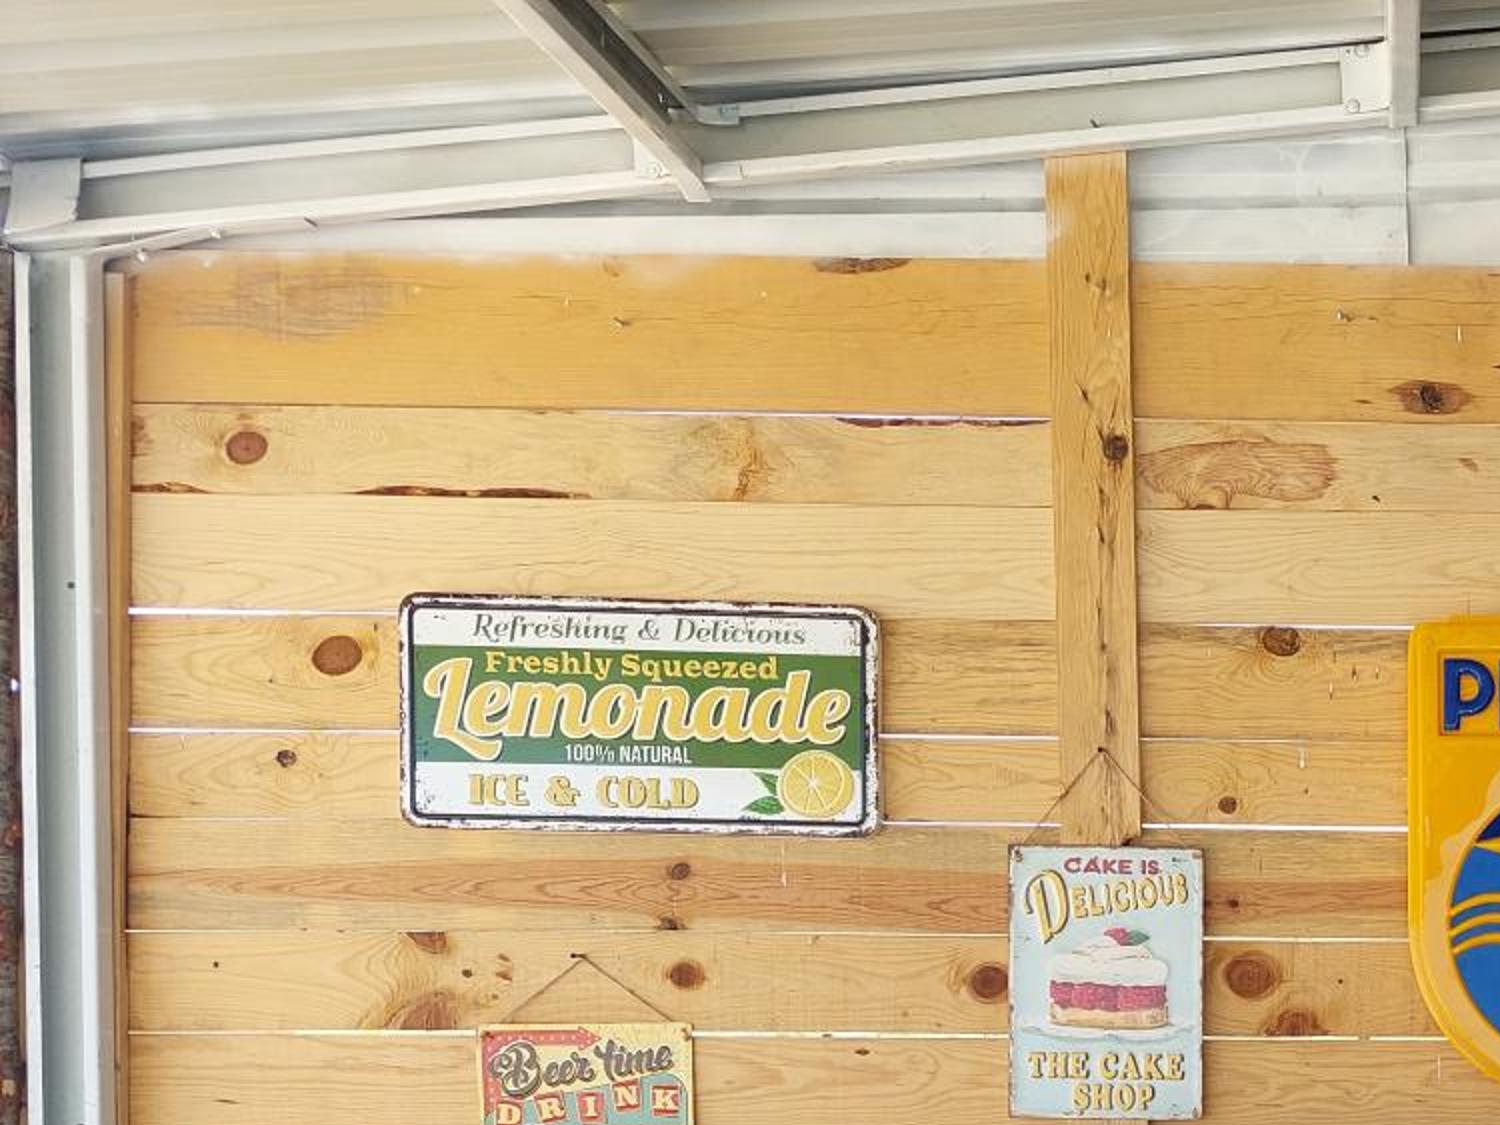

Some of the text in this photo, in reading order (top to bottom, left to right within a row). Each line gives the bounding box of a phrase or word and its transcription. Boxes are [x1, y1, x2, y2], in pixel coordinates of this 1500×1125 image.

[473, 613, 807, 645] Refreshing & Delicious
[485, 651, 779, 682] Freshly Squeezed
[423, 656, 852, 762] Lemonade
[565, 743, 693, 764] 100% NATURAL
[468, 774, 700, 810] ICE & COLD
[1064, 857, 1161, 875] CAKE IS
[489, 1039, 674, 1098] Beer time
[1029, 1051, 1186, 1081] THE CAKE
[1073, 1082, 1157, 1113] SHOP
